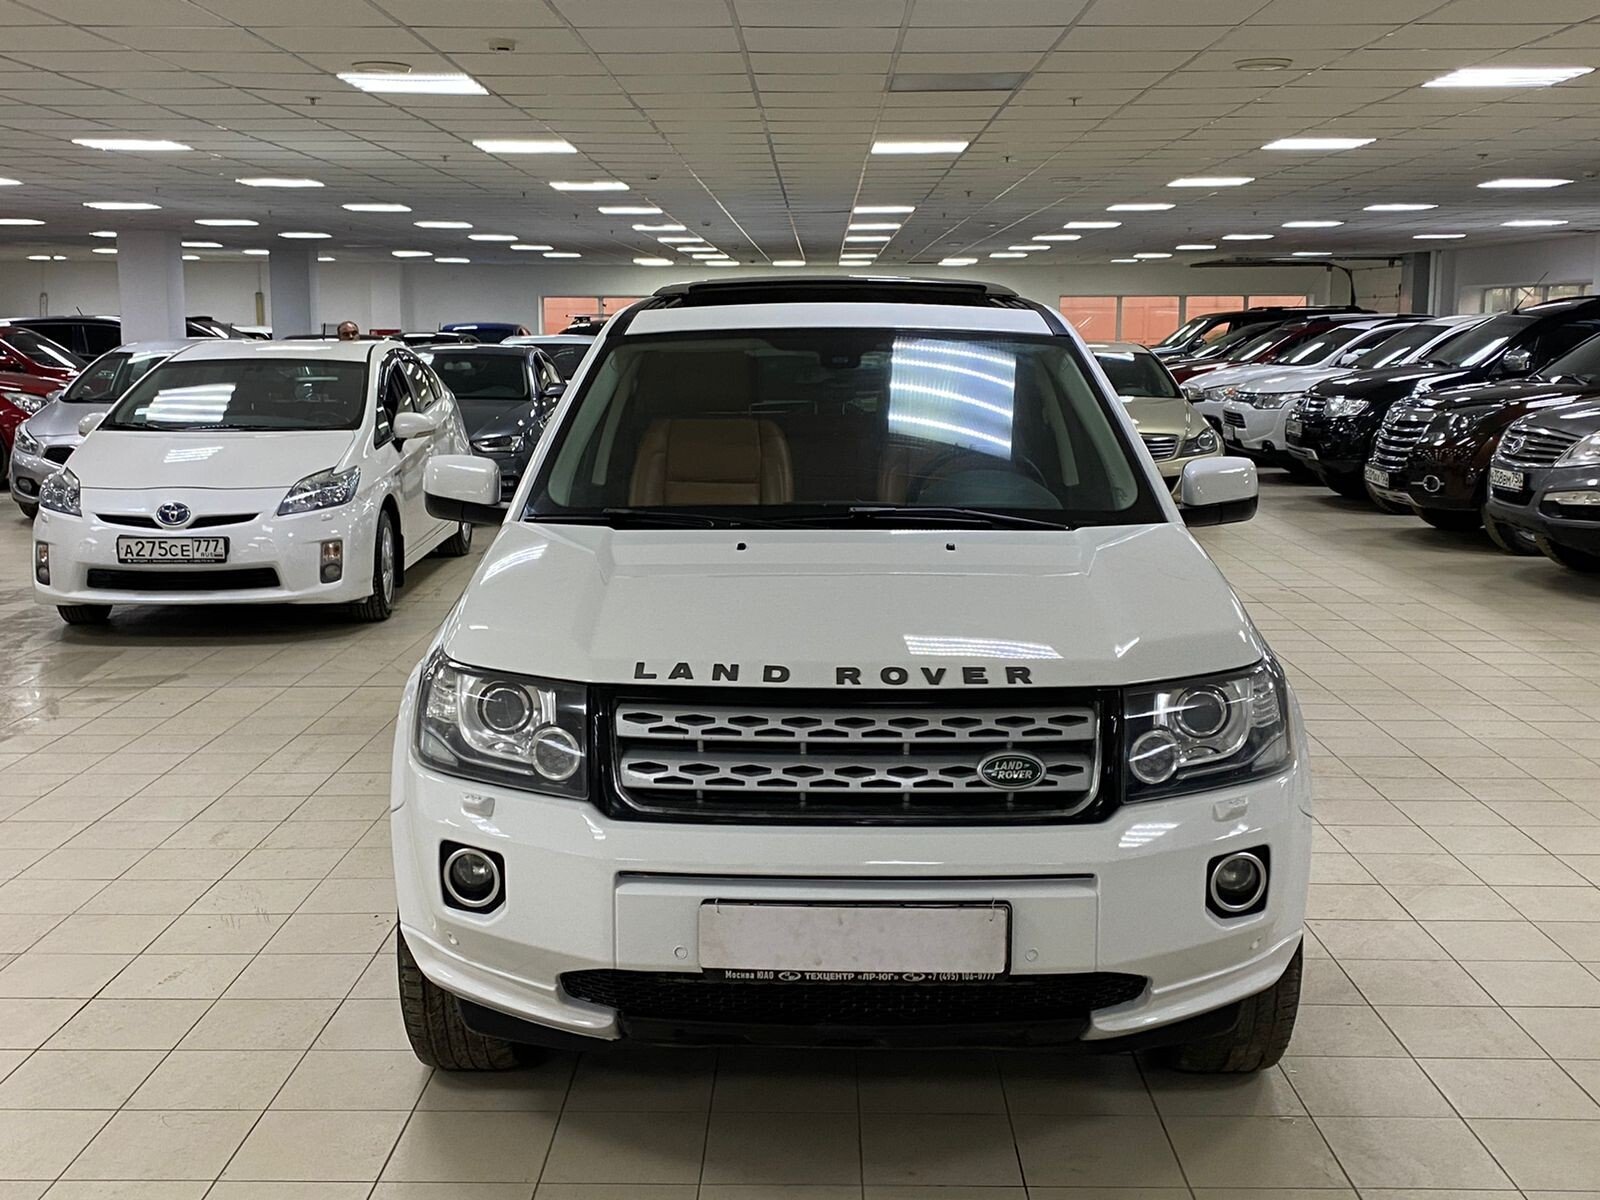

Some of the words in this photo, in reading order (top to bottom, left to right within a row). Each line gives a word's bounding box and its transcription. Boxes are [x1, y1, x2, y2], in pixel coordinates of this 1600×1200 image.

[124, 540, 190, 557] А275СЕ
[193, 539, 219, 552] 777
[634, 661, 790, 684] LAND
[836, 665, 1033, 686] ROVER
[994, 761, 1025, 771] LAND
[998, 770, 1033, 779] ROVER
[725, 970, 754, 980] Москва
[757, 971, 774, 980] ЮАО
[804, 972, 855, 982] ТЕХЦЕНТР
